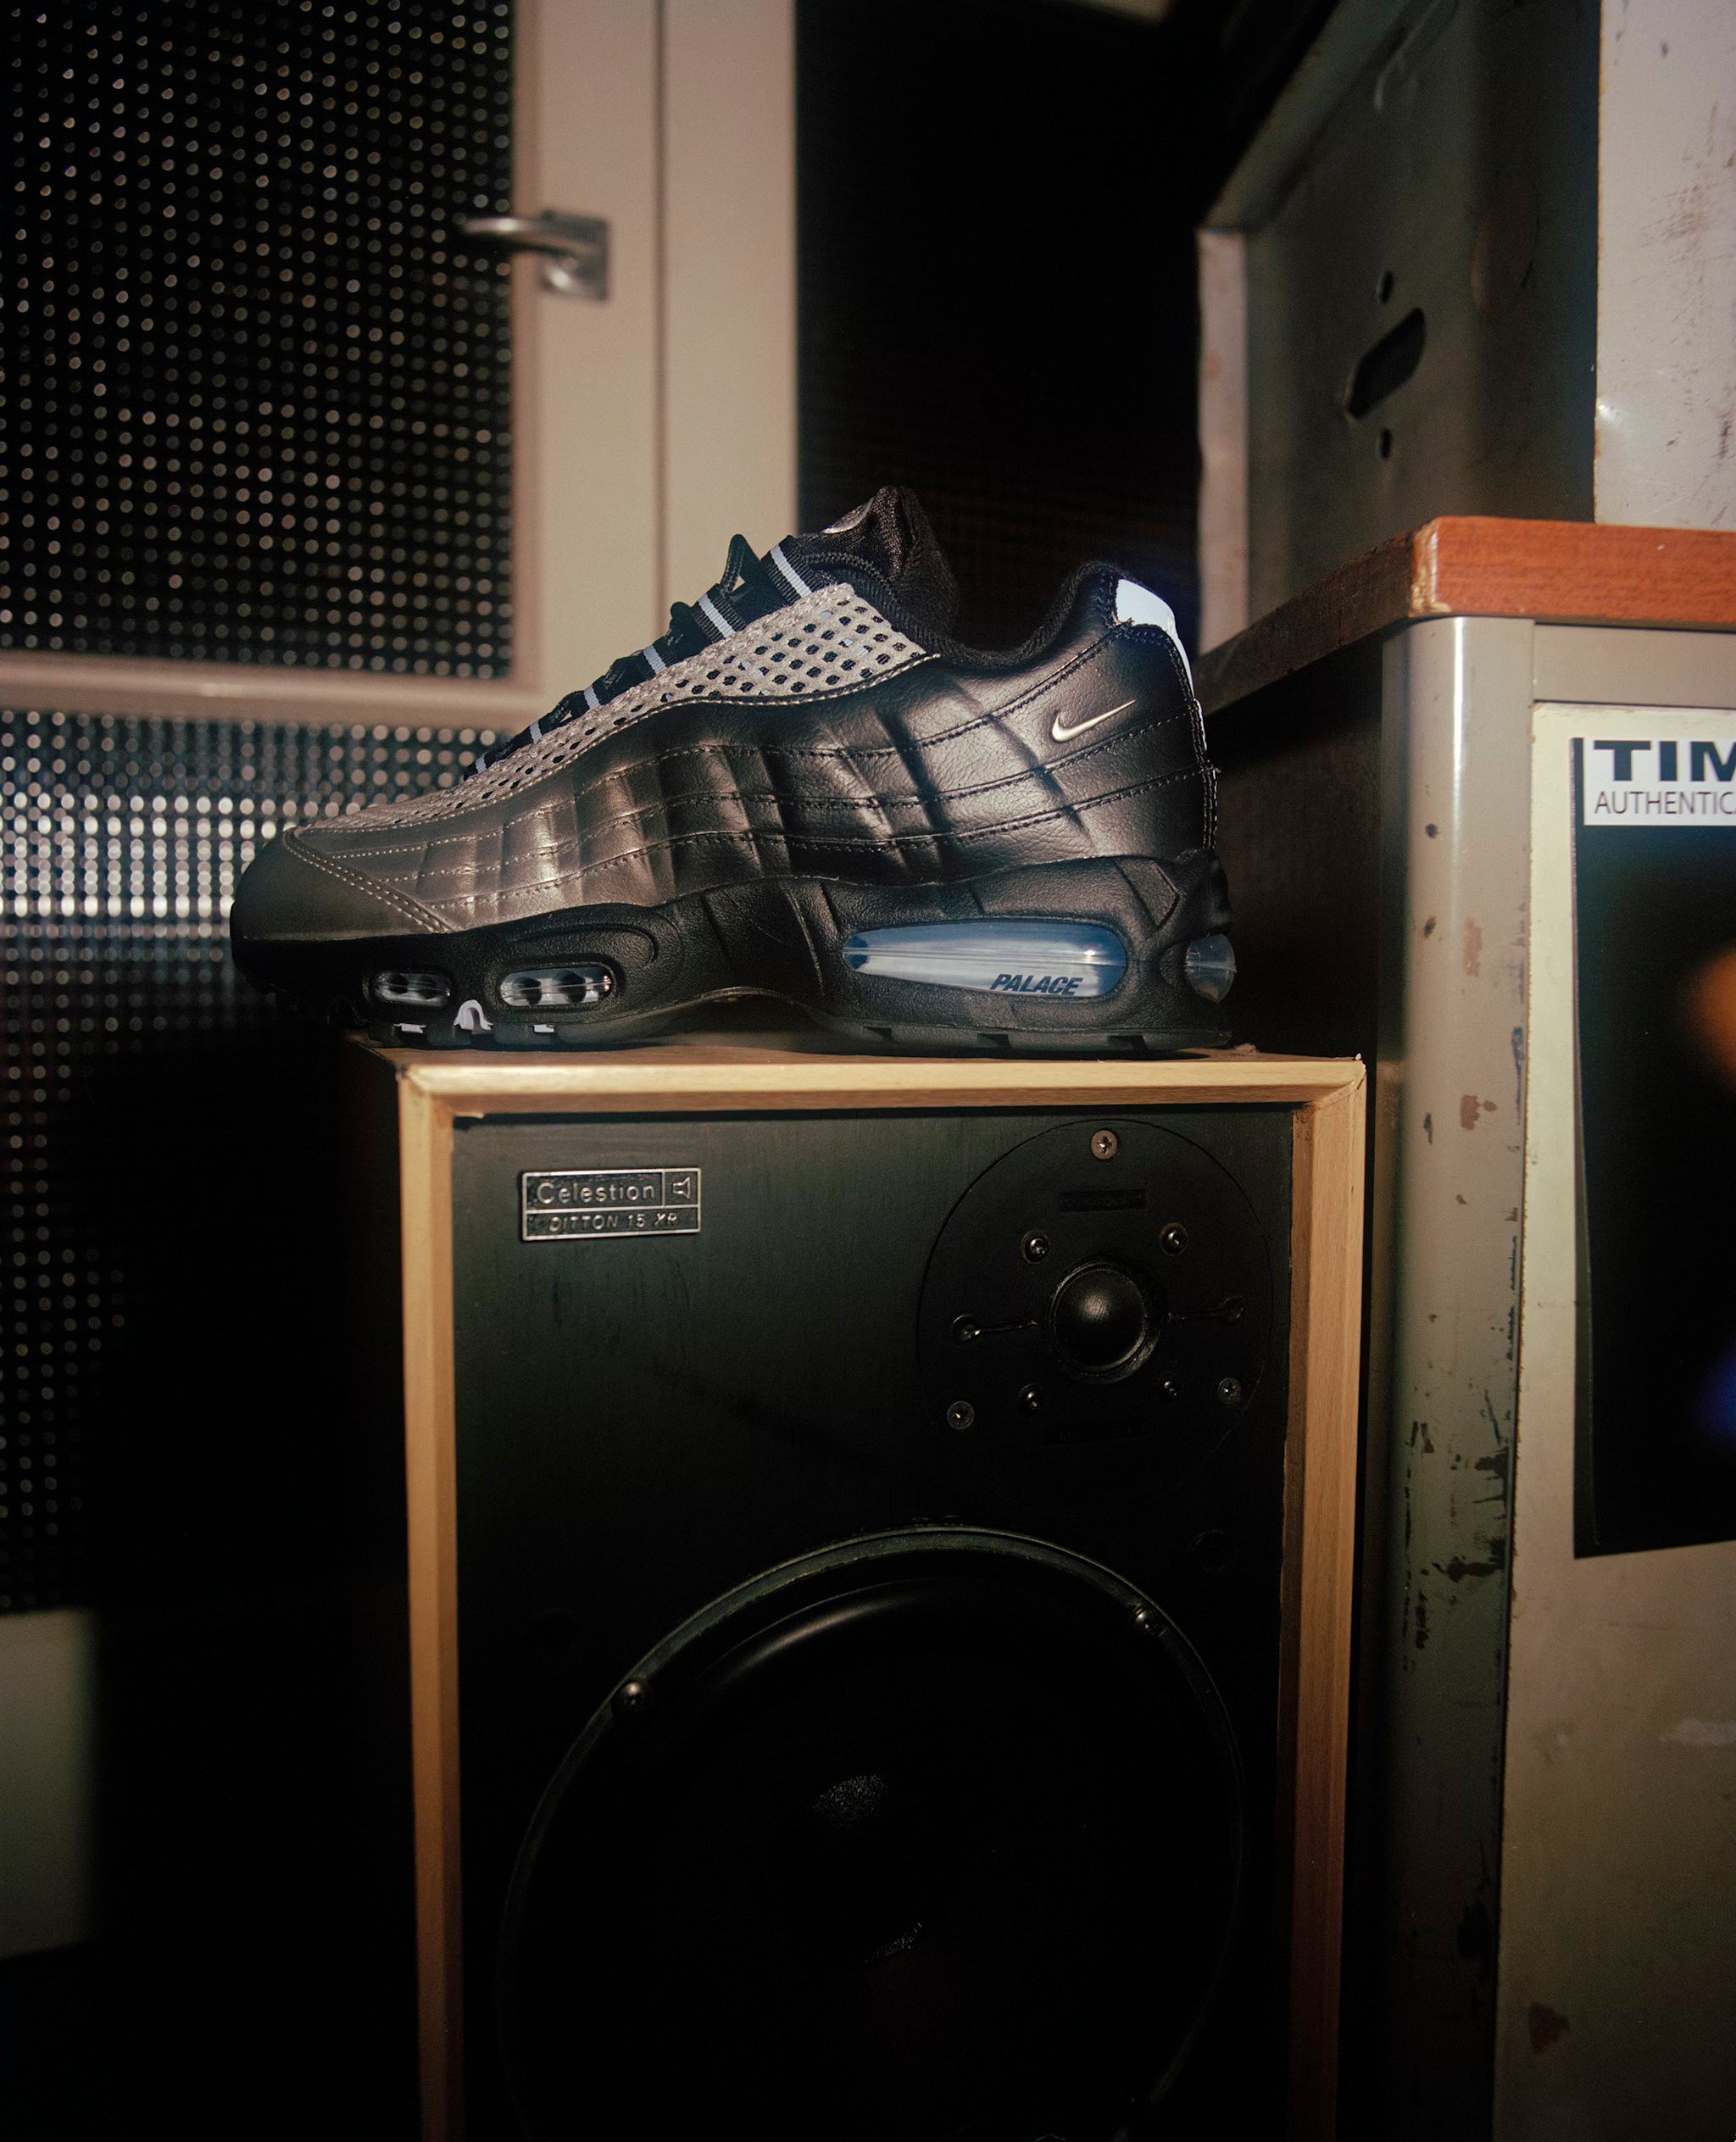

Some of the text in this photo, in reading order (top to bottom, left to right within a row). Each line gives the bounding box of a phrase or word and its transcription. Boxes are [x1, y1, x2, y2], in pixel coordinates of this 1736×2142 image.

[1594, 740, 1736, 782] TIM
[1594, 791, 1736, 815] AUTHENTIC
[990, 973, 1083, 996] PALACE
[537, 1182, 655, 1205] Celestion
[548, 1215, 619, 1232] DITTON
[628, 1213, 646, 1228] 15
